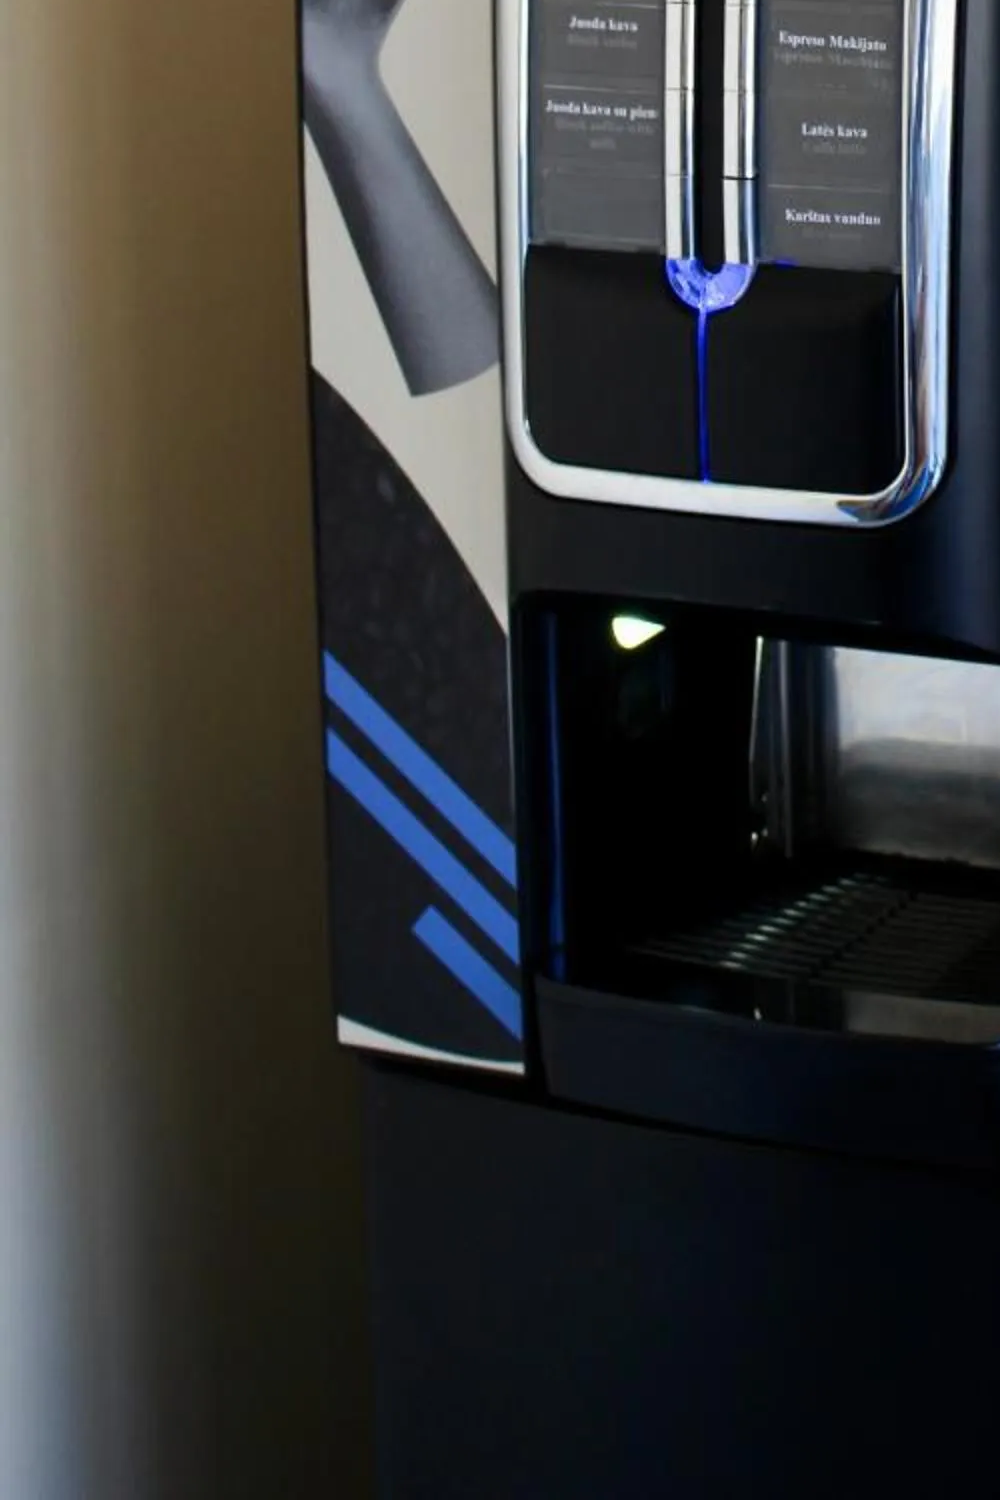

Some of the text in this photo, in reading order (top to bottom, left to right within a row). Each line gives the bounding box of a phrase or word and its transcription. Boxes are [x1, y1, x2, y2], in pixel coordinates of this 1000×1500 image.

[608, 17, 639, 32] kava
[582, 102, 611, 116] kava
[837, 123, 868, 139] kava
